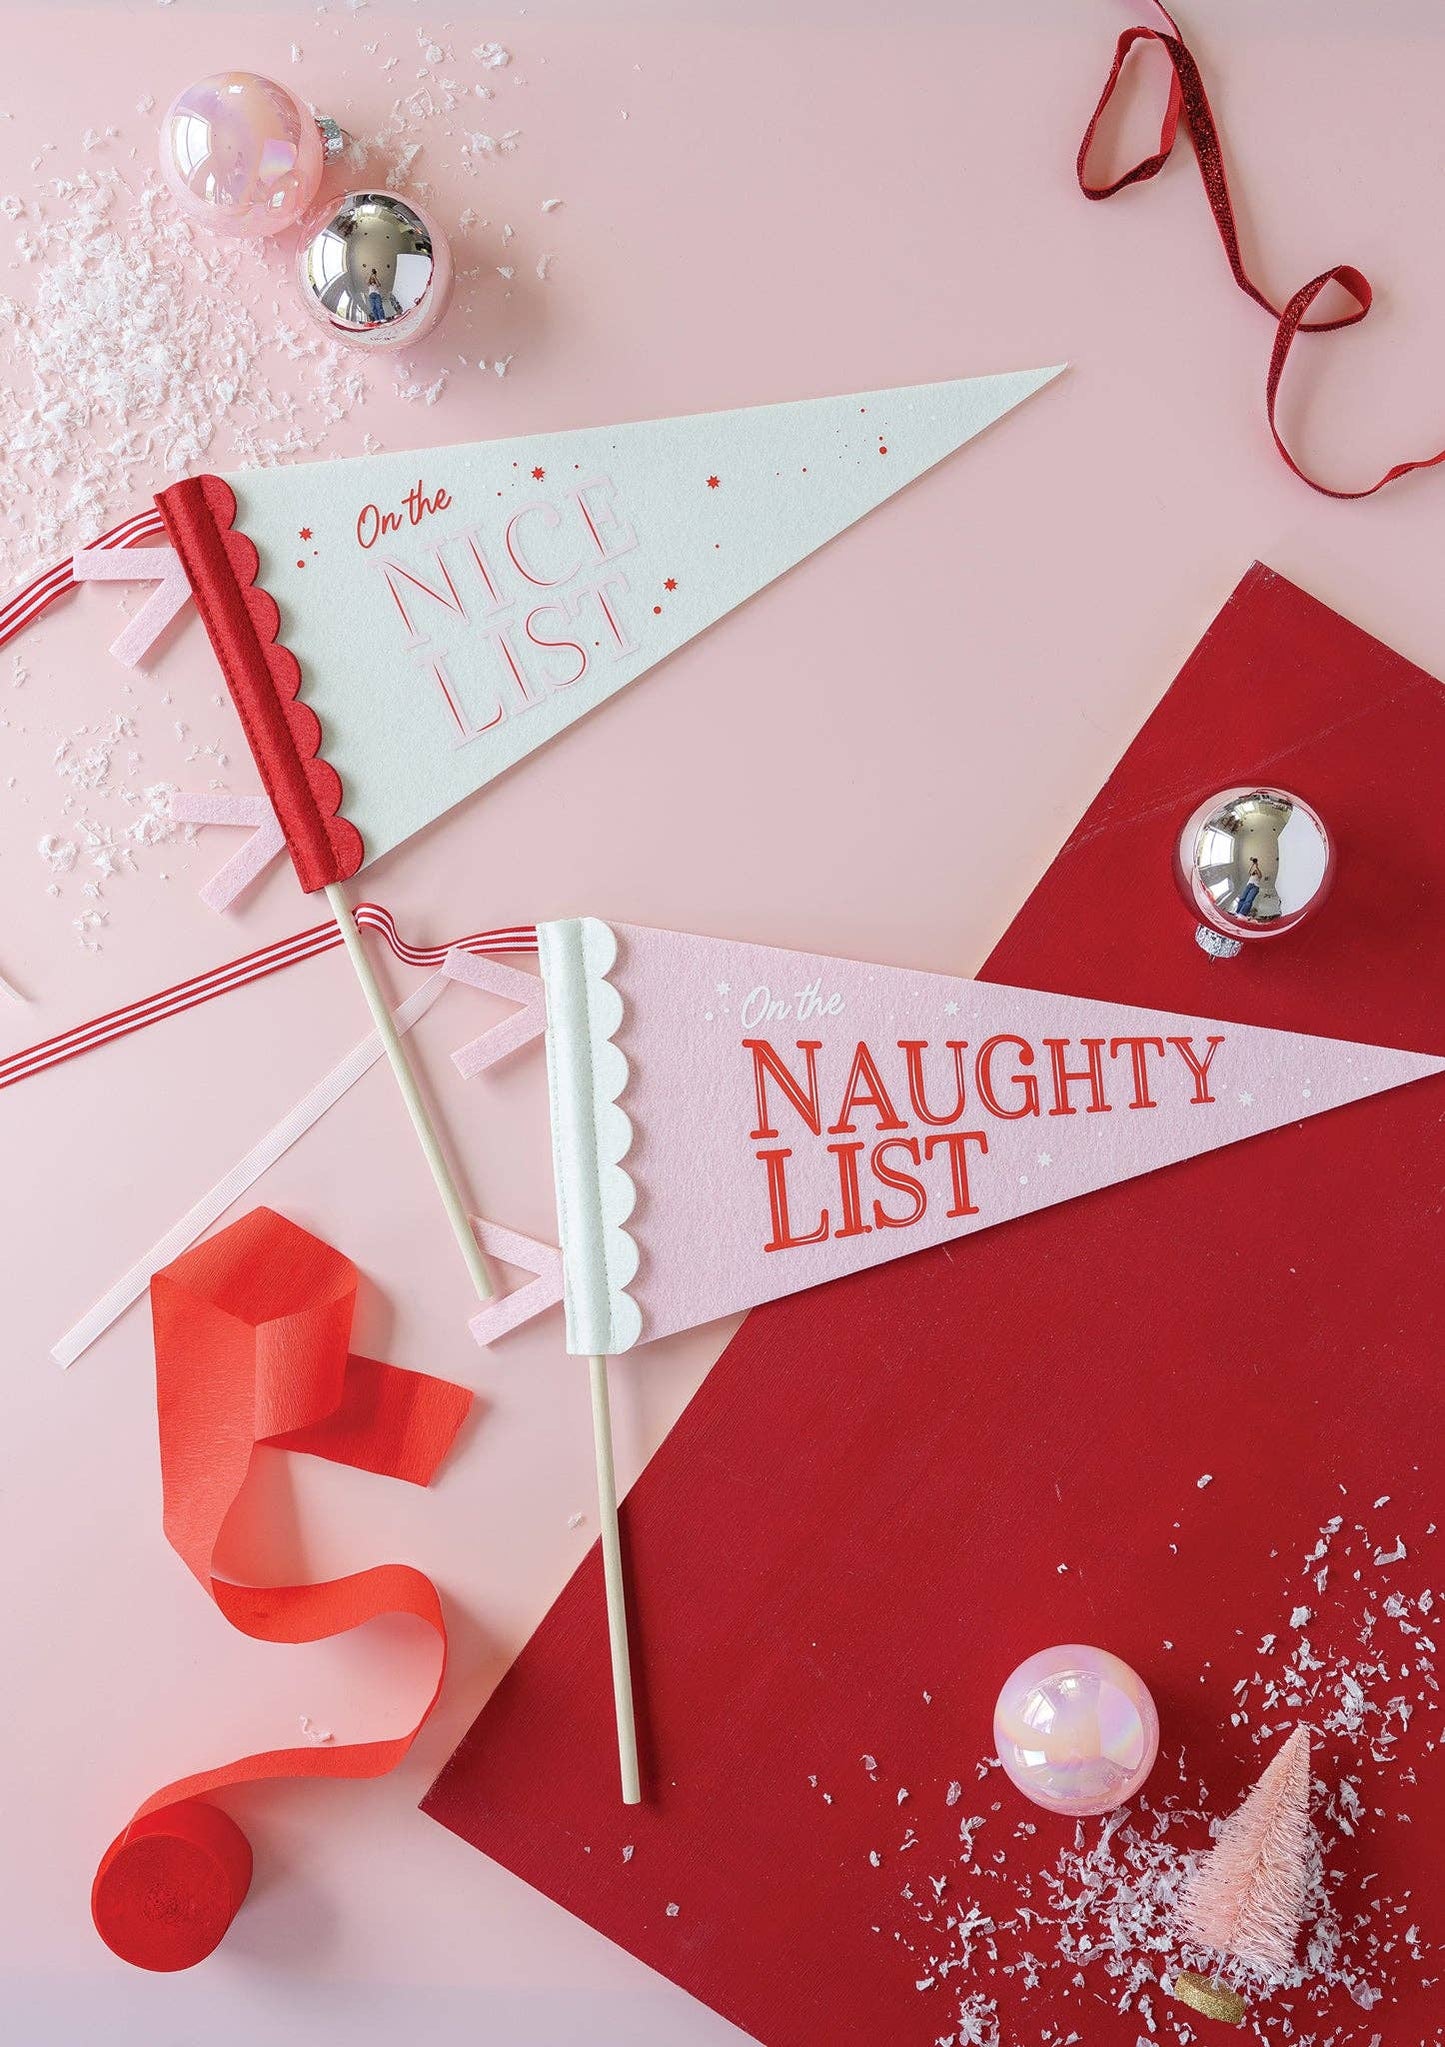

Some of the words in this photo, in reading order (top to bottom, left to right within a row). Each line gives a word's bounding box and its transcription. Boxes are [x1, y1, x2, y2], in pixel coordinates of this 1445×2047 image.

[357, 504, 402, 549] On
[401, 479, 452, 525] the
[366, 475, 640, 650] NICE
[414, 571, 640, 750] LIST
[740, 985, 792, 1029] On
[791, 978, 846, 1021] the
[741, 1033, 1226, 1139] NAUGHTY
[755, 1131, 989, 1253] LIST
